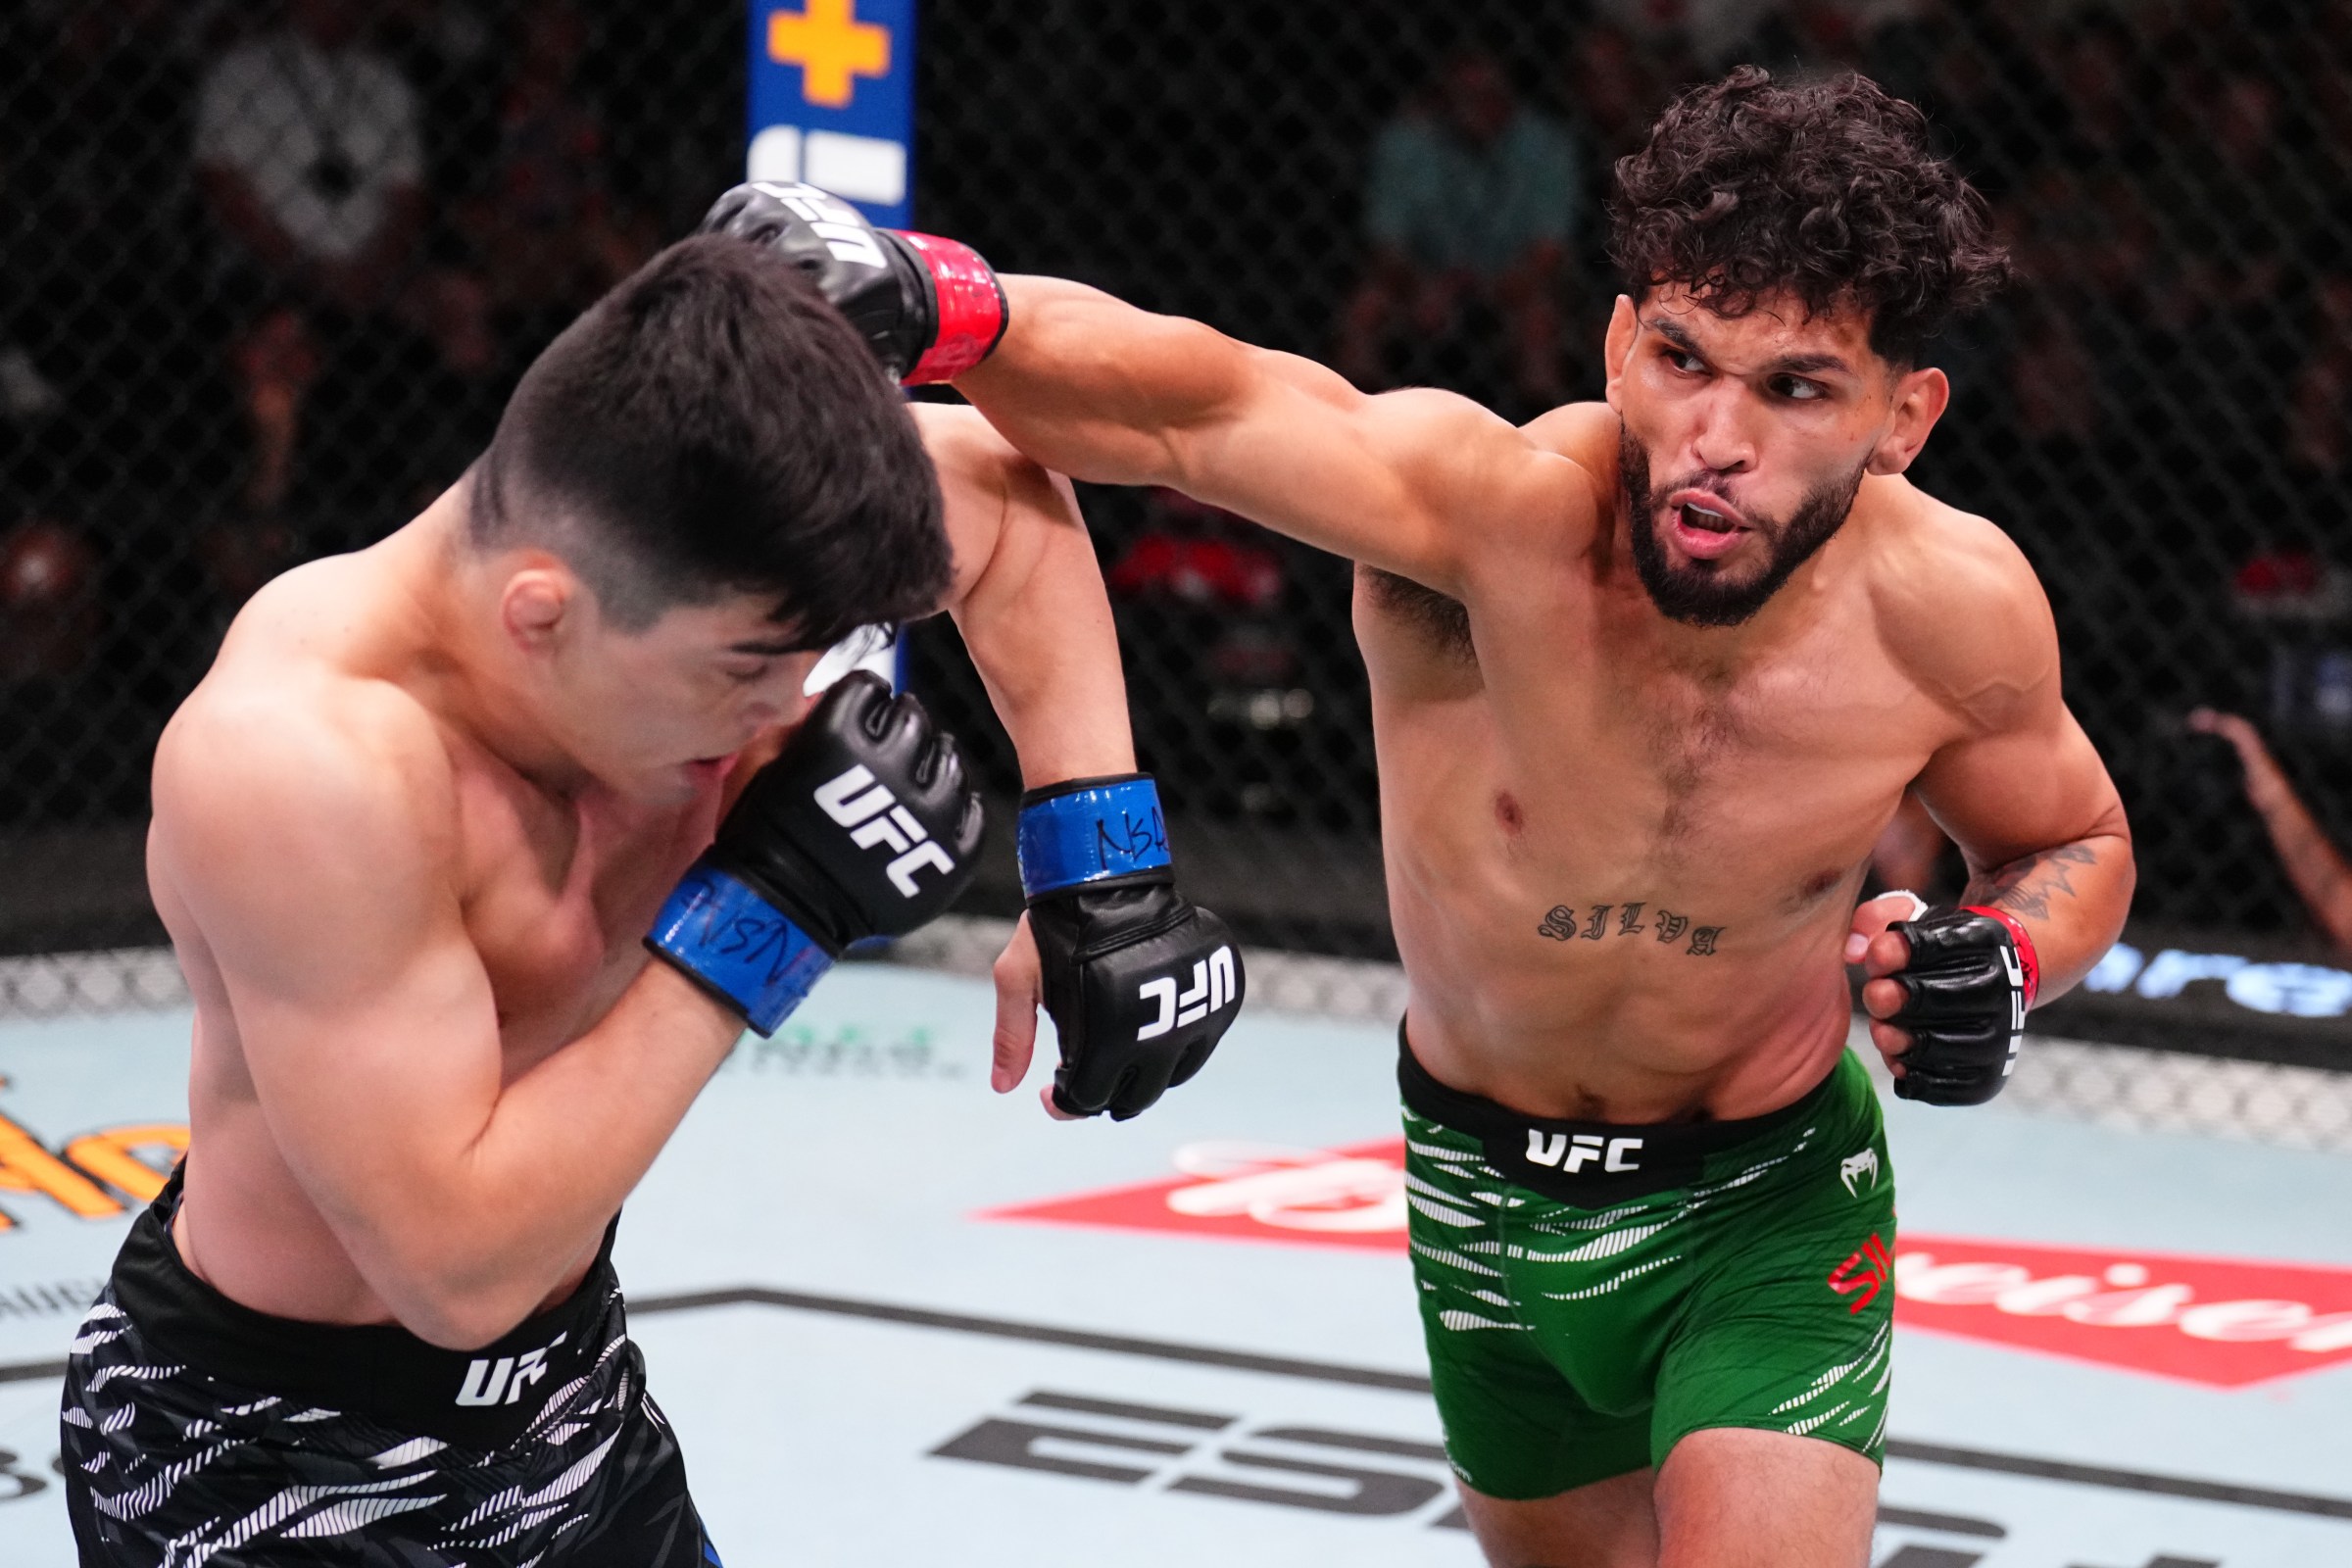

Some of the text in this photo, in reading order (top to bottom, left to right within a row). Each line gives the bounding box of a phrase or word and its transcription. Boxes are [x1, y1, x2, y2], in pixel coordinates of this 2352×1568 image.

[813, 763, 956, 899] UFC
[1537, 902, 1727, 956] SILVA
[1136, 945, 1236, 1042] UFC
[1525, 1128, 1643, 1174] UFC
